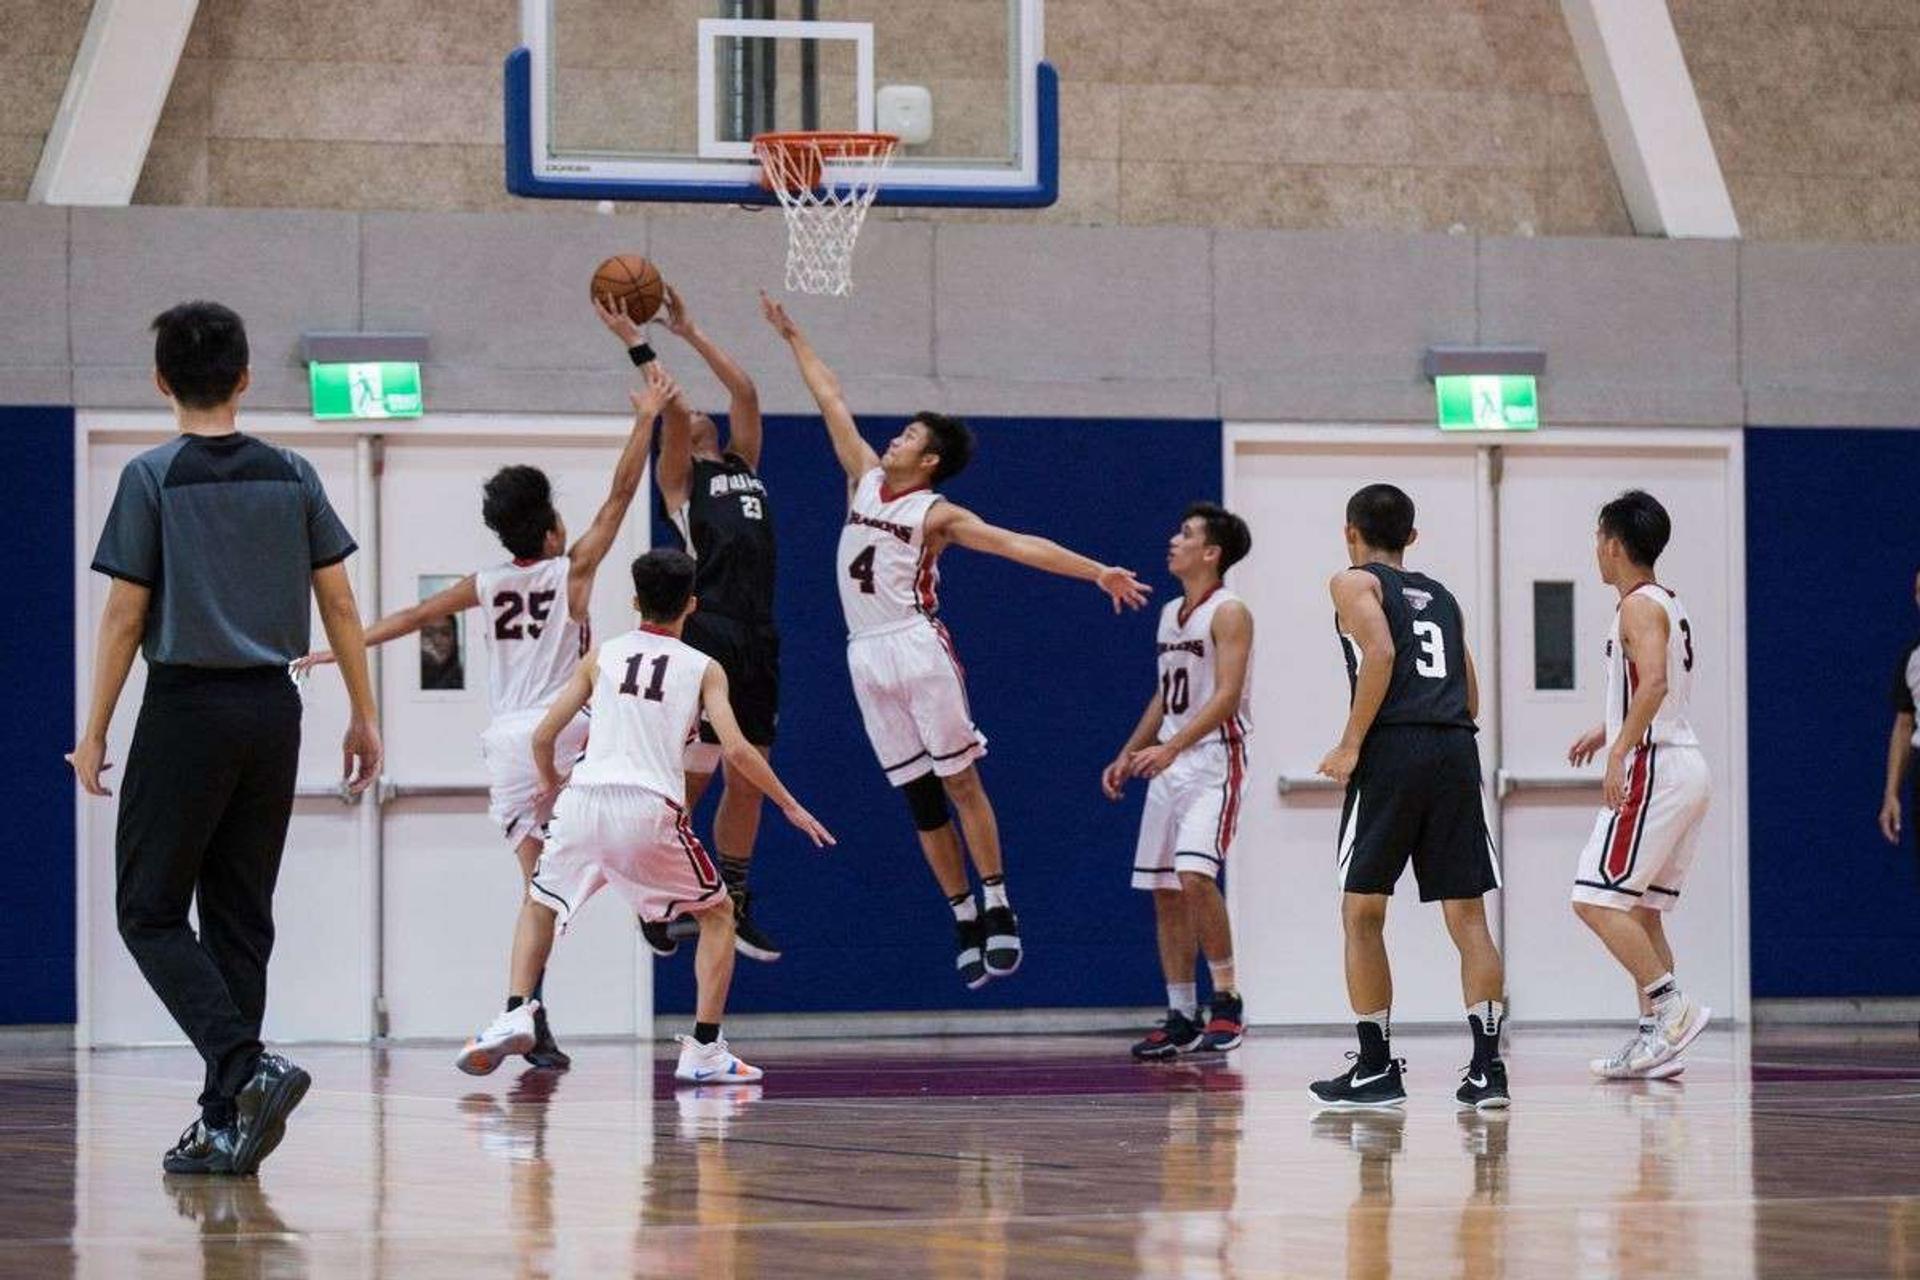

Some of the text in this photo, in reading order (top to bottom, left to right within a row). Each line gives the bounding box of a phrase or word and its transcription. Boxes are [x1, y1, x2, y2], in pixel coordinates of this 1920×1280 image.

[740, 494, 763, 520] 23
[849, 545, 877, 595] 4
[493, 589, 556, 640] 25
[1412, 619, 1448, 679] 3
[618, 652, 670, 703] 11
[1162, 667, 1190, 716] 10
